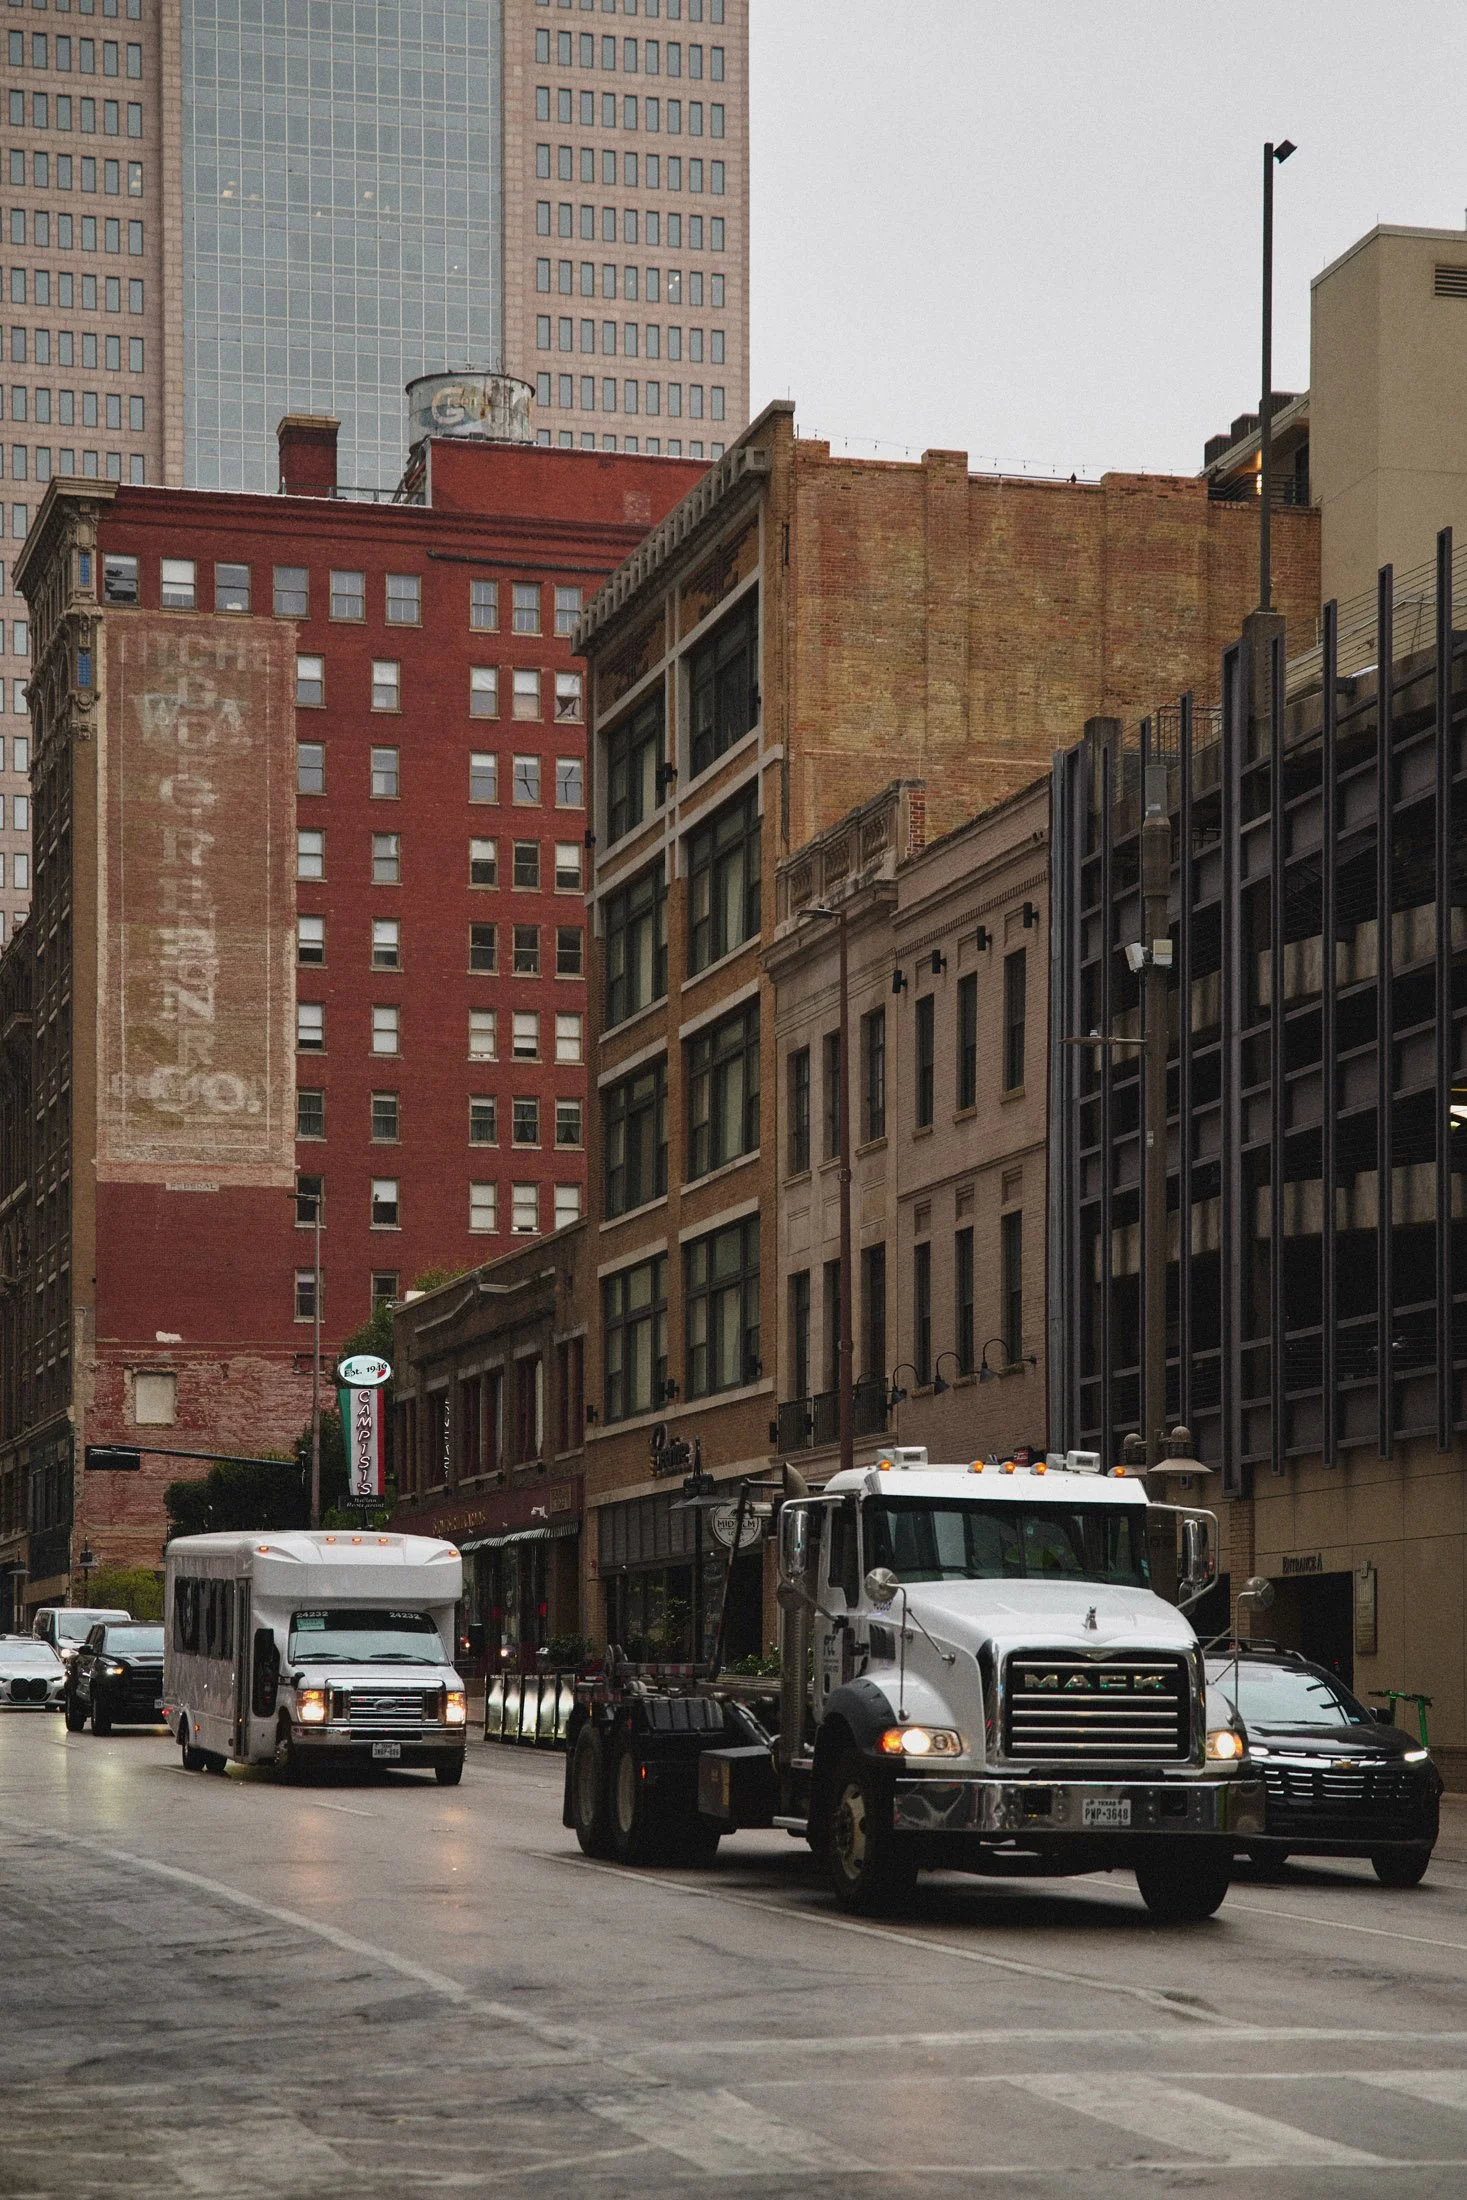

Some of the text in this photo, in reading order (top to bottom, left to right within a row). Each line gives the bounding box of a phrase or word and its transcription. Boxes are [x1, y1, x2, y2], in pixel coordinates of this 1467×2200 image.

[356, 1389, 372, 1495] CAMPISI'S
[389, 1611, 422, 1620] 24232
[1024, 1674, 1166, 1690] MACK
